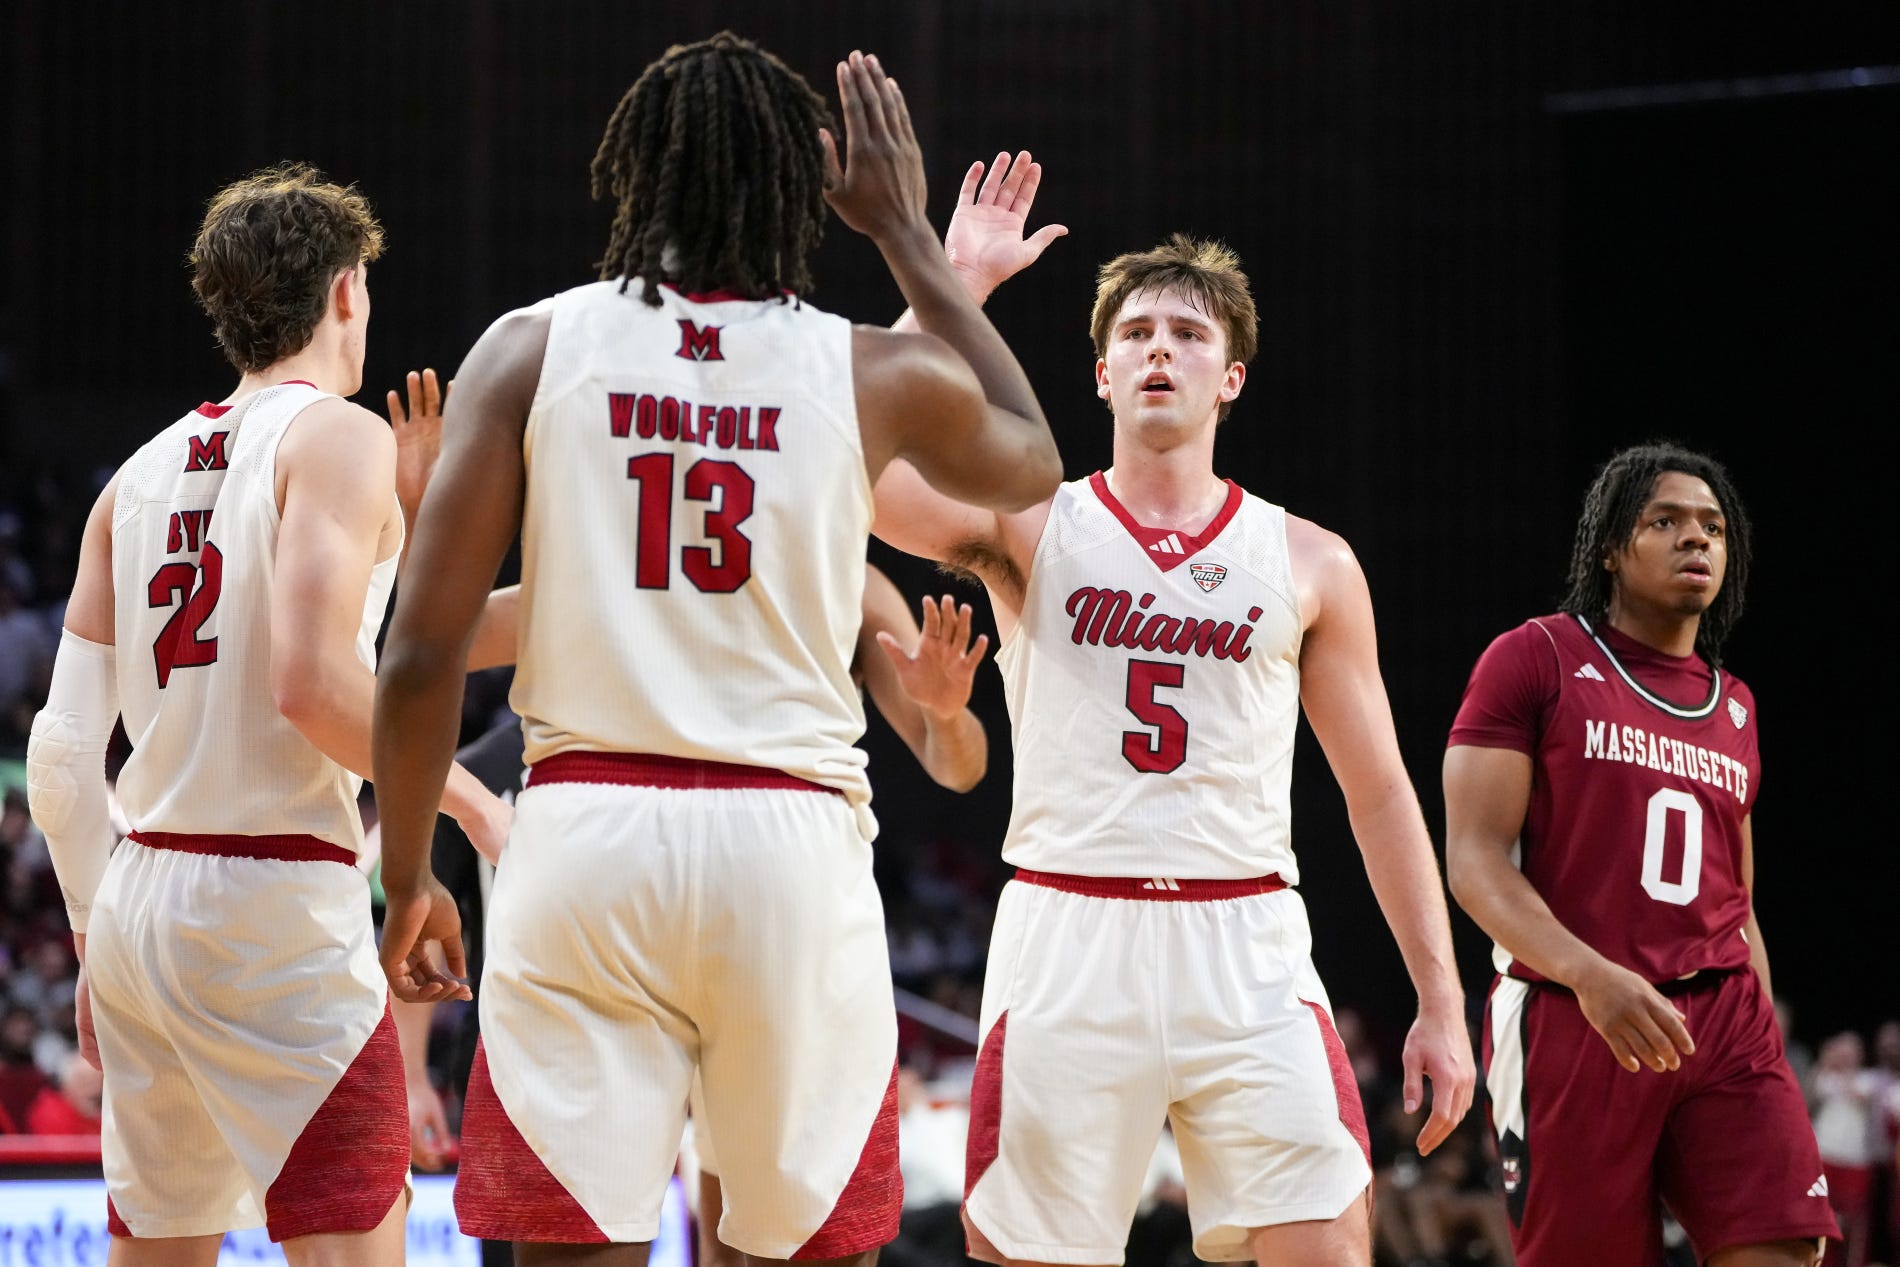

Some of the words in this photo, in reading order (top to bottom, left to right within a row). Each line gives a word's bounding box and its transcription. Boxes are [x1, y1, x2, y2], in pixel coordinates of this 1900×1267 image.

[674, 319, 726, 361] M
[184, 431, 230, 472] M
[608, 392, 782, 452] WOOLFOLK
[627, 453, 755, 593] 13
[148, 541, 223, 690] 22
[1192, 570, 1225, 582] MAC
[1065, 586, 1264, 663] Miami
[1122, 658, 1188, 775] 5
[1584, 720, 1748, 804] MASSACHUSETTS
[1640, 787, 1703, 906] 0
